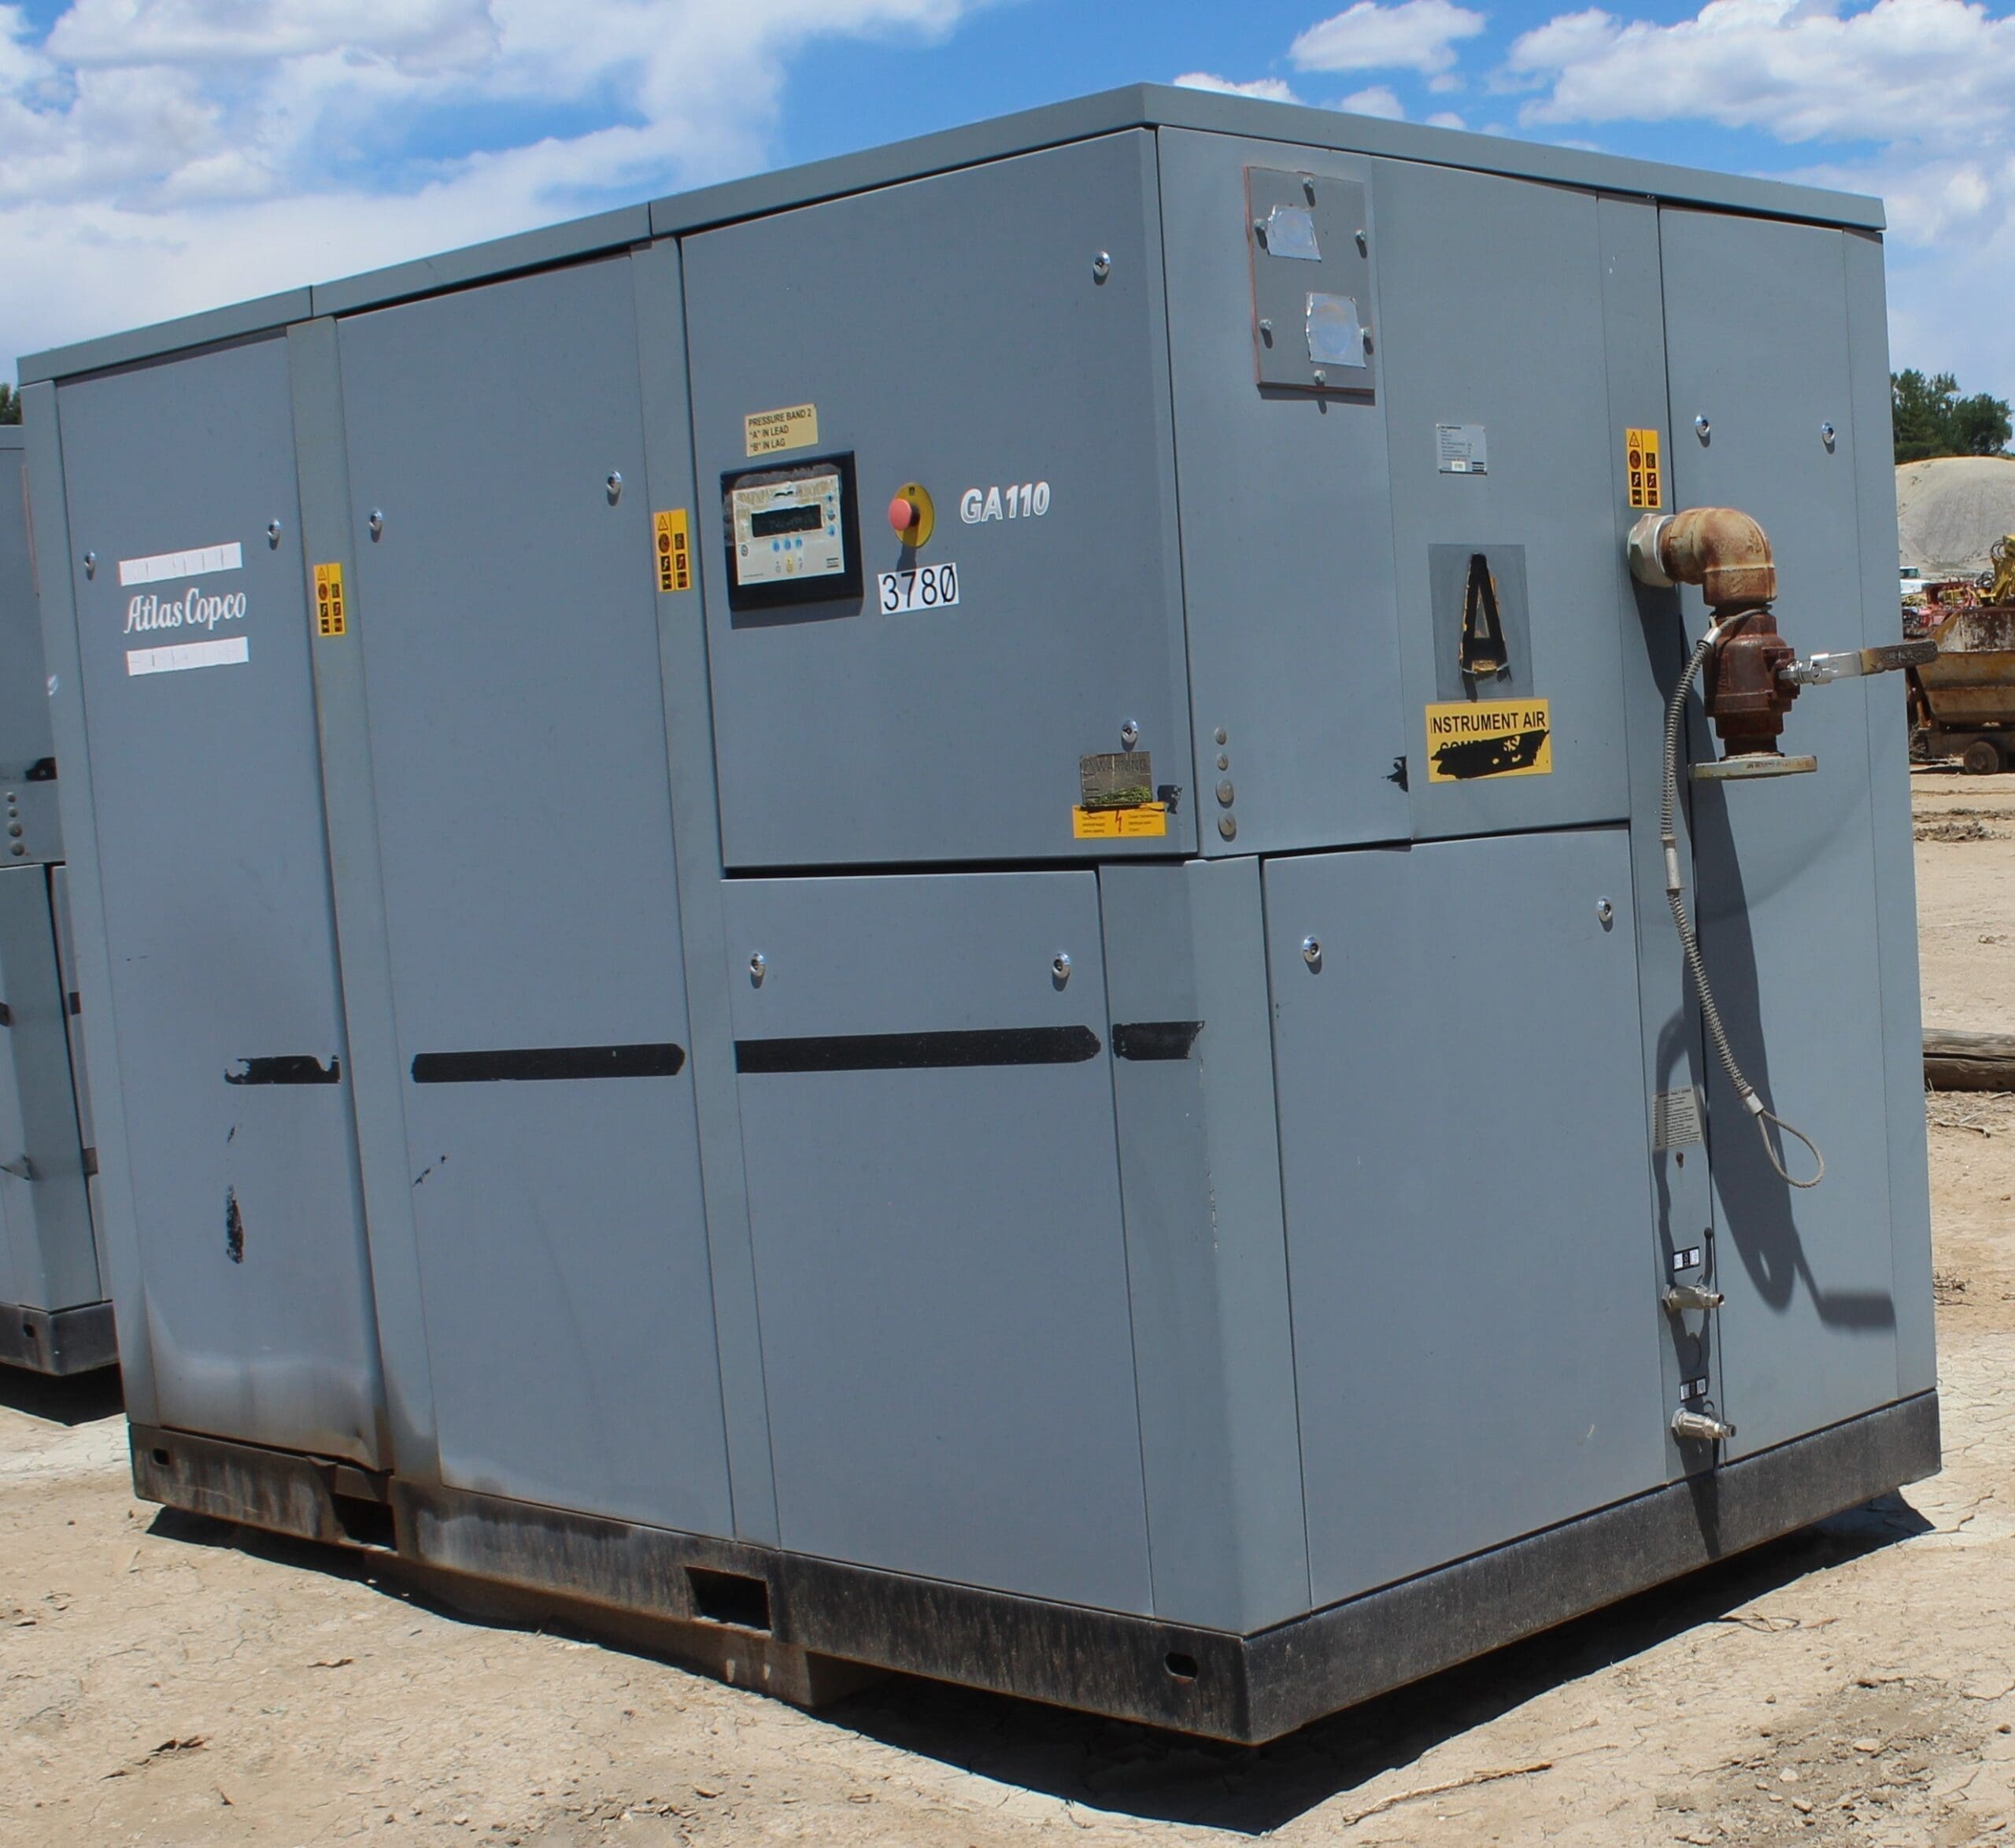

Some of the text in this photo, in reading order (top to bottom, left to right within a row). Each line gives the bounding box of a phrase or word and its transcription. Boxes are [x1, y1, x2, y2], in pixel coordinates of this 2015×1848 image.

[749, 408, 812, 427] PRESSURE BAND 2
[761, 429, 770, 438] IN
[771, 425, 789, 436] LEAD
[762, 441, 770, 449] IN
[771, 438, 786, 449] LAG
[882, 564, 956, 612] 3780
[124, 587, 246, 634] Atlas Copco
[1460, 553, 1509, 675] A
[1523, 711, 1547, 728] AIR
[1096, 758, 1147, 772] WARNING
